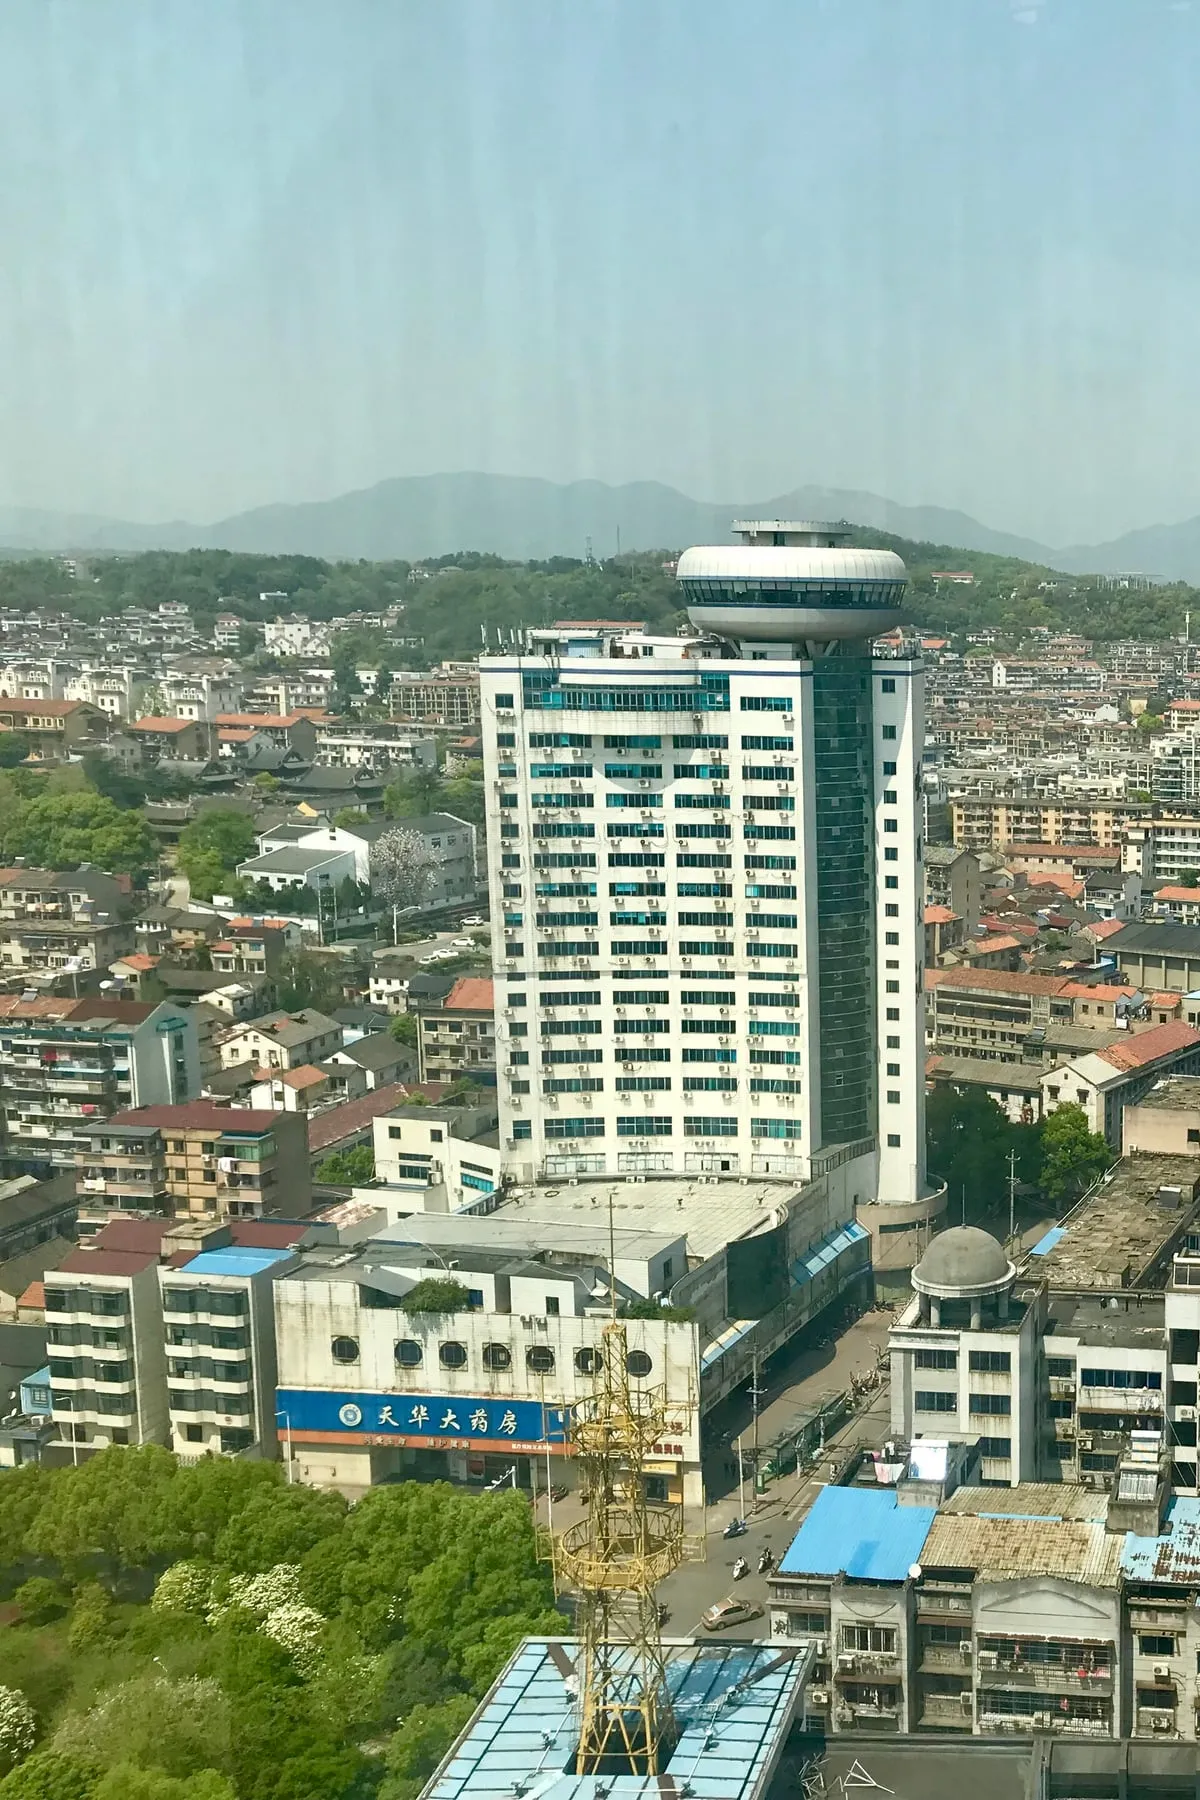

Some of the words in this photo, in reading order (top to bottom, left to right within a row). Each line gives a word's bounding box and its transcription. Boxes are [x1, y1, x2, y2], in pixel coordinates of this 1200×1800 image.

[378, 1405, 518, 1435] 天华大药房
